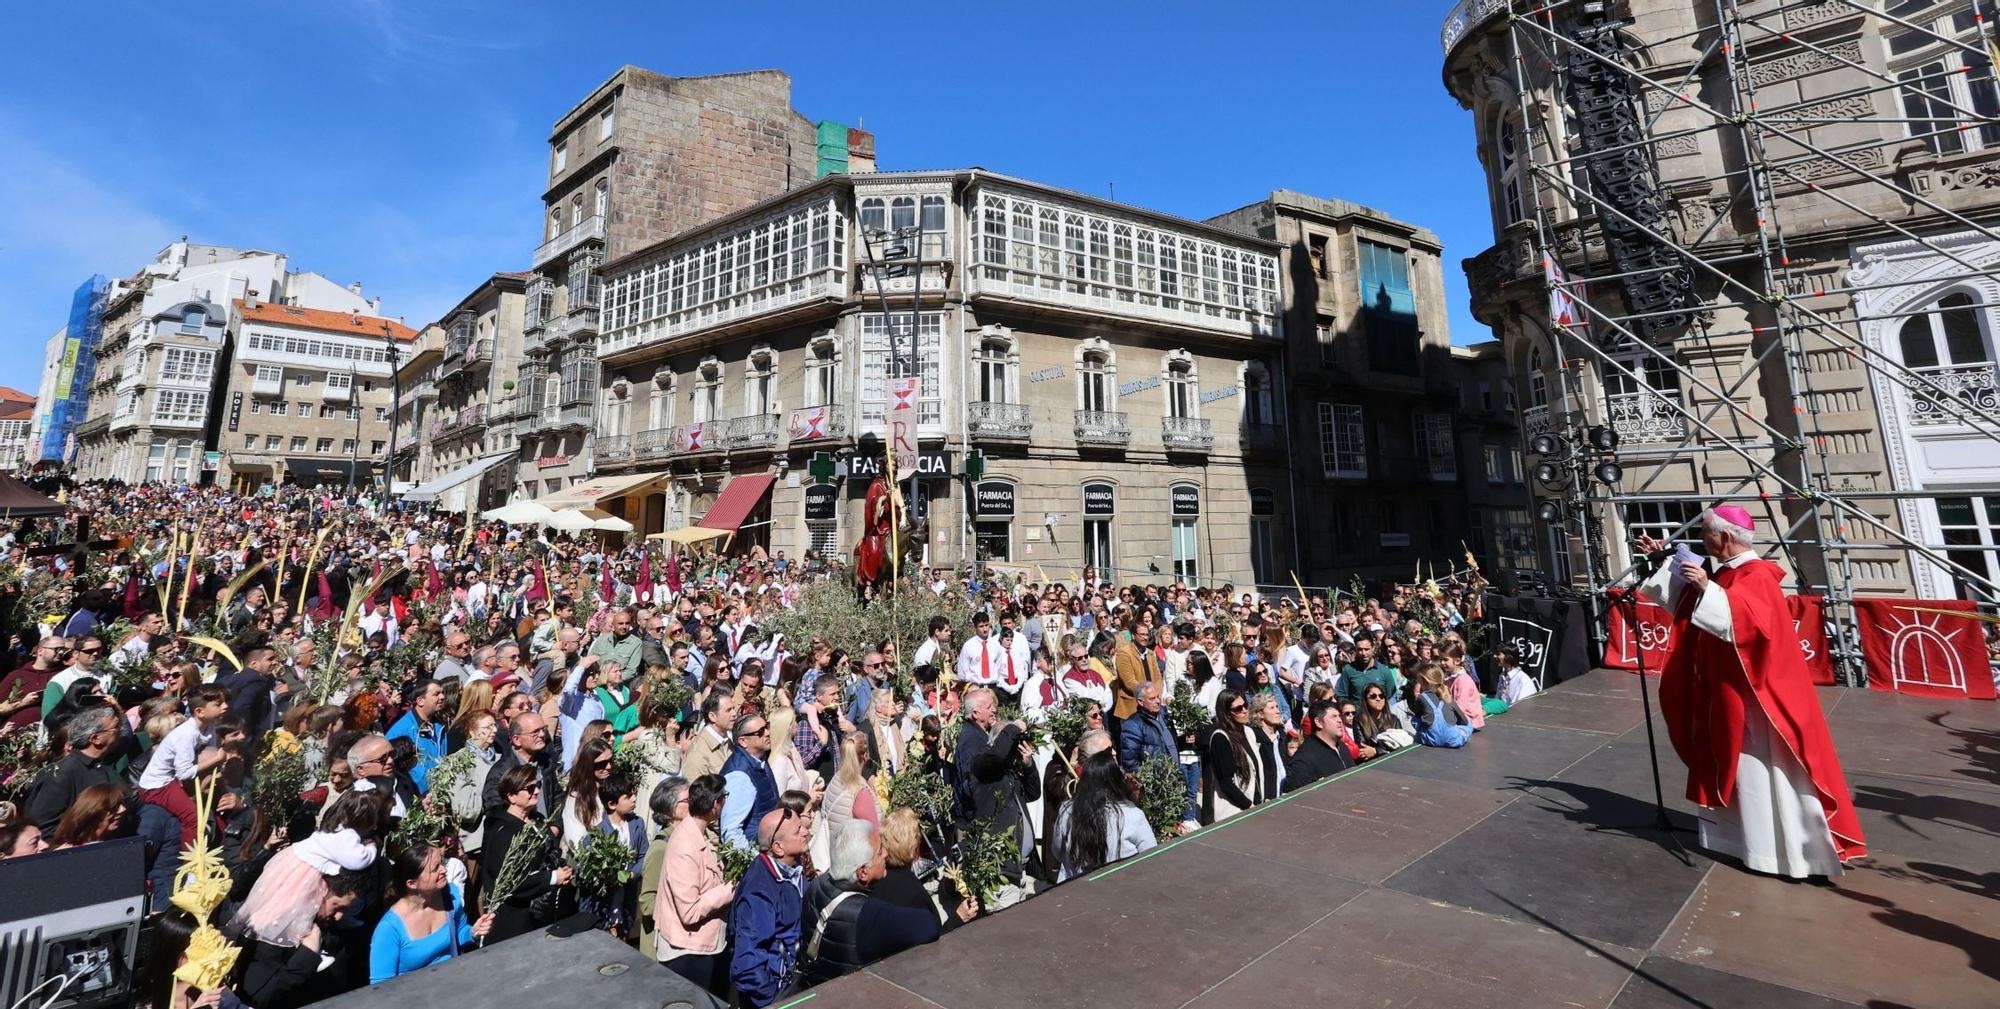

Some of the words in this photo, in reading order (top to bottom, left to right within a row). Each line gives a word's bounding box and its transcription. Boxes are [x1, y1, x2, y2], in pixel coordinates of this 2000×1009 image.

[231, 392, 241, 425] HOTEL
[892, 421, 914, 452] R
[852, 456, 946, 474] FACIA
[806, 495, 834, 504] FARMACIA
[979, 491, 1013, 500] FARMACIA
[1085, 492, 1112, 500] FARMACIA
